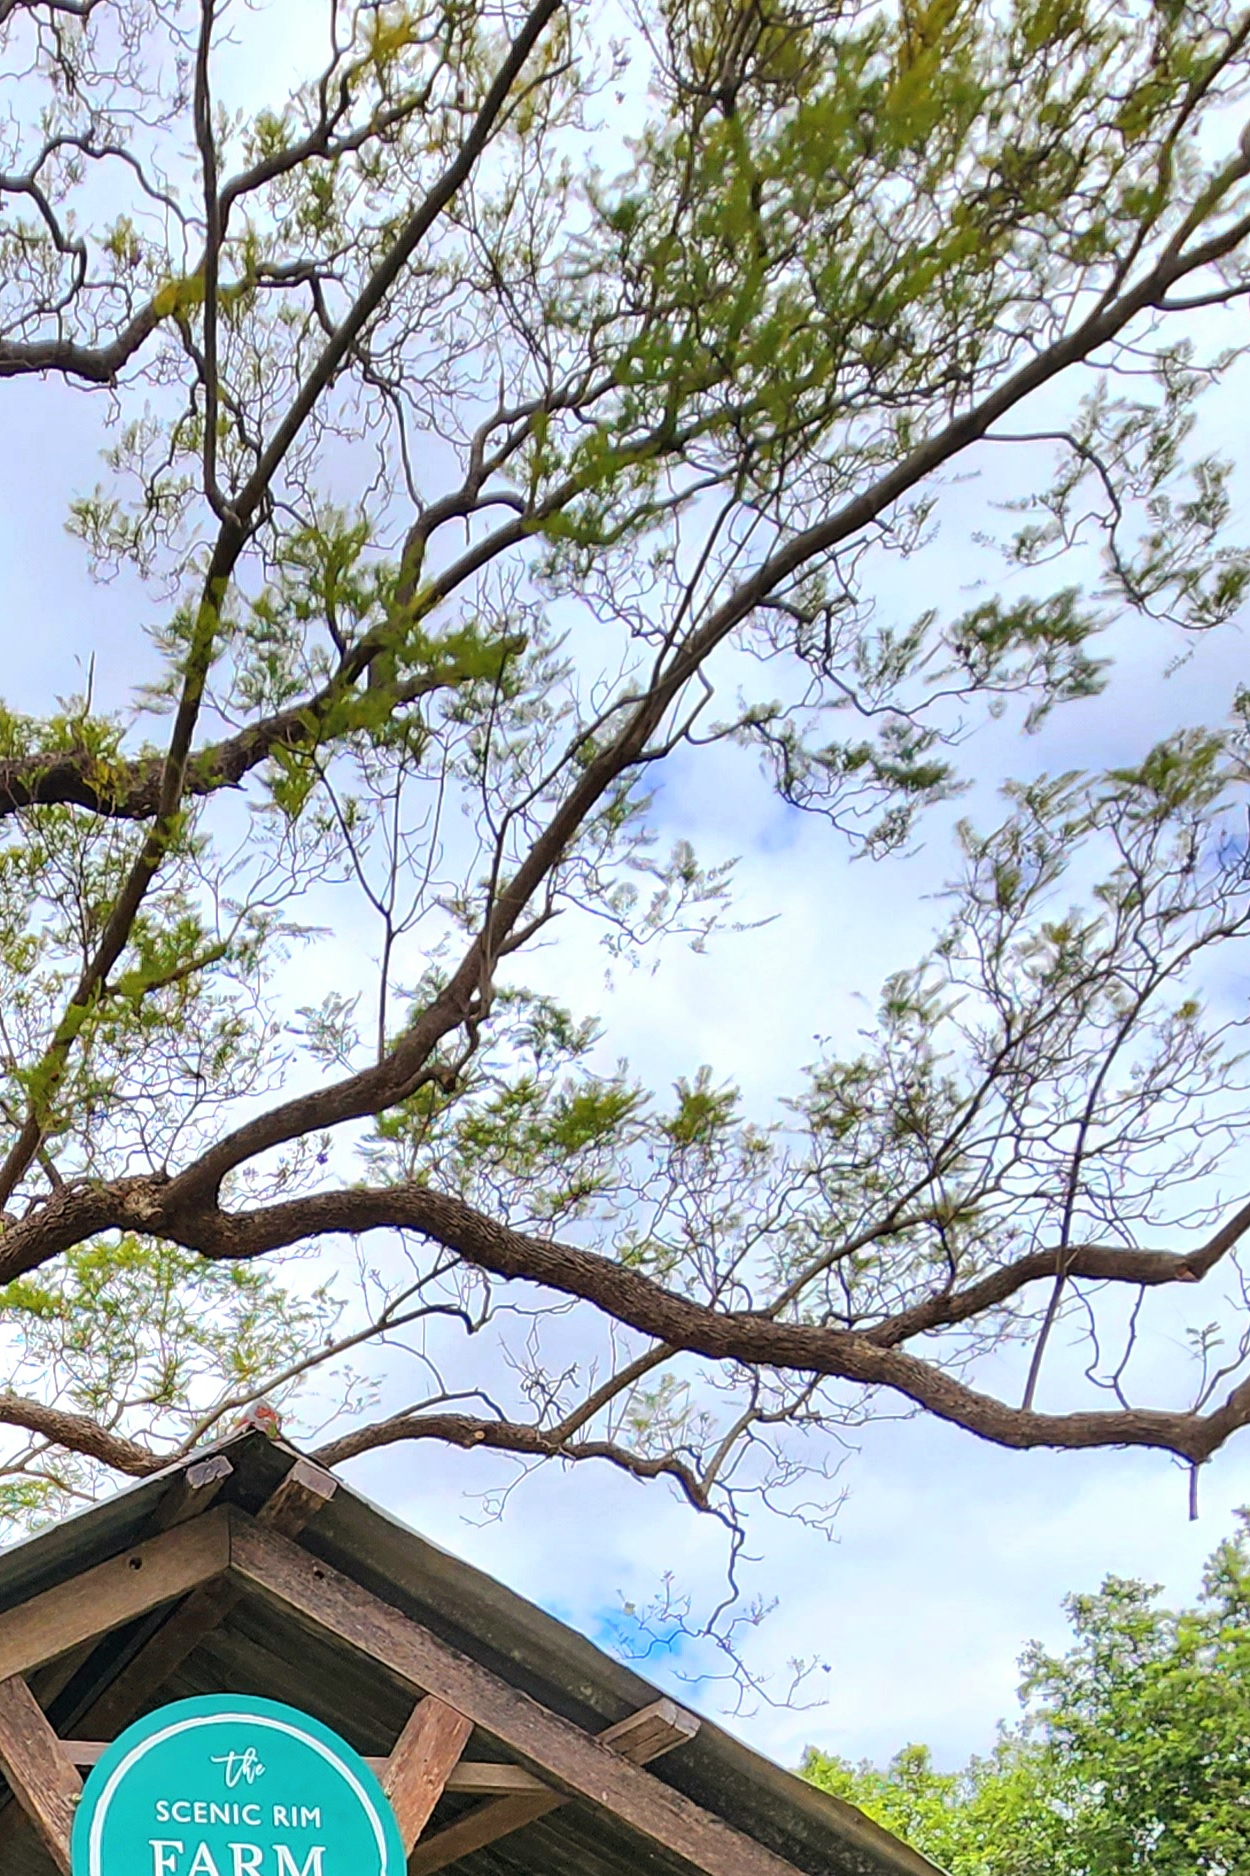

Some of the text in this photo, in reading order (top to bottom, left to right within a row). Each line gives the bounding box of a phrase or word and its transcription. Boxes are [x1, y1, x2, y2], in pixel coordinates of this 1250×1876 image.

[210, 1747, 266, 1788] the
[155, 1800, 322, 1829] SCENIC RIM
